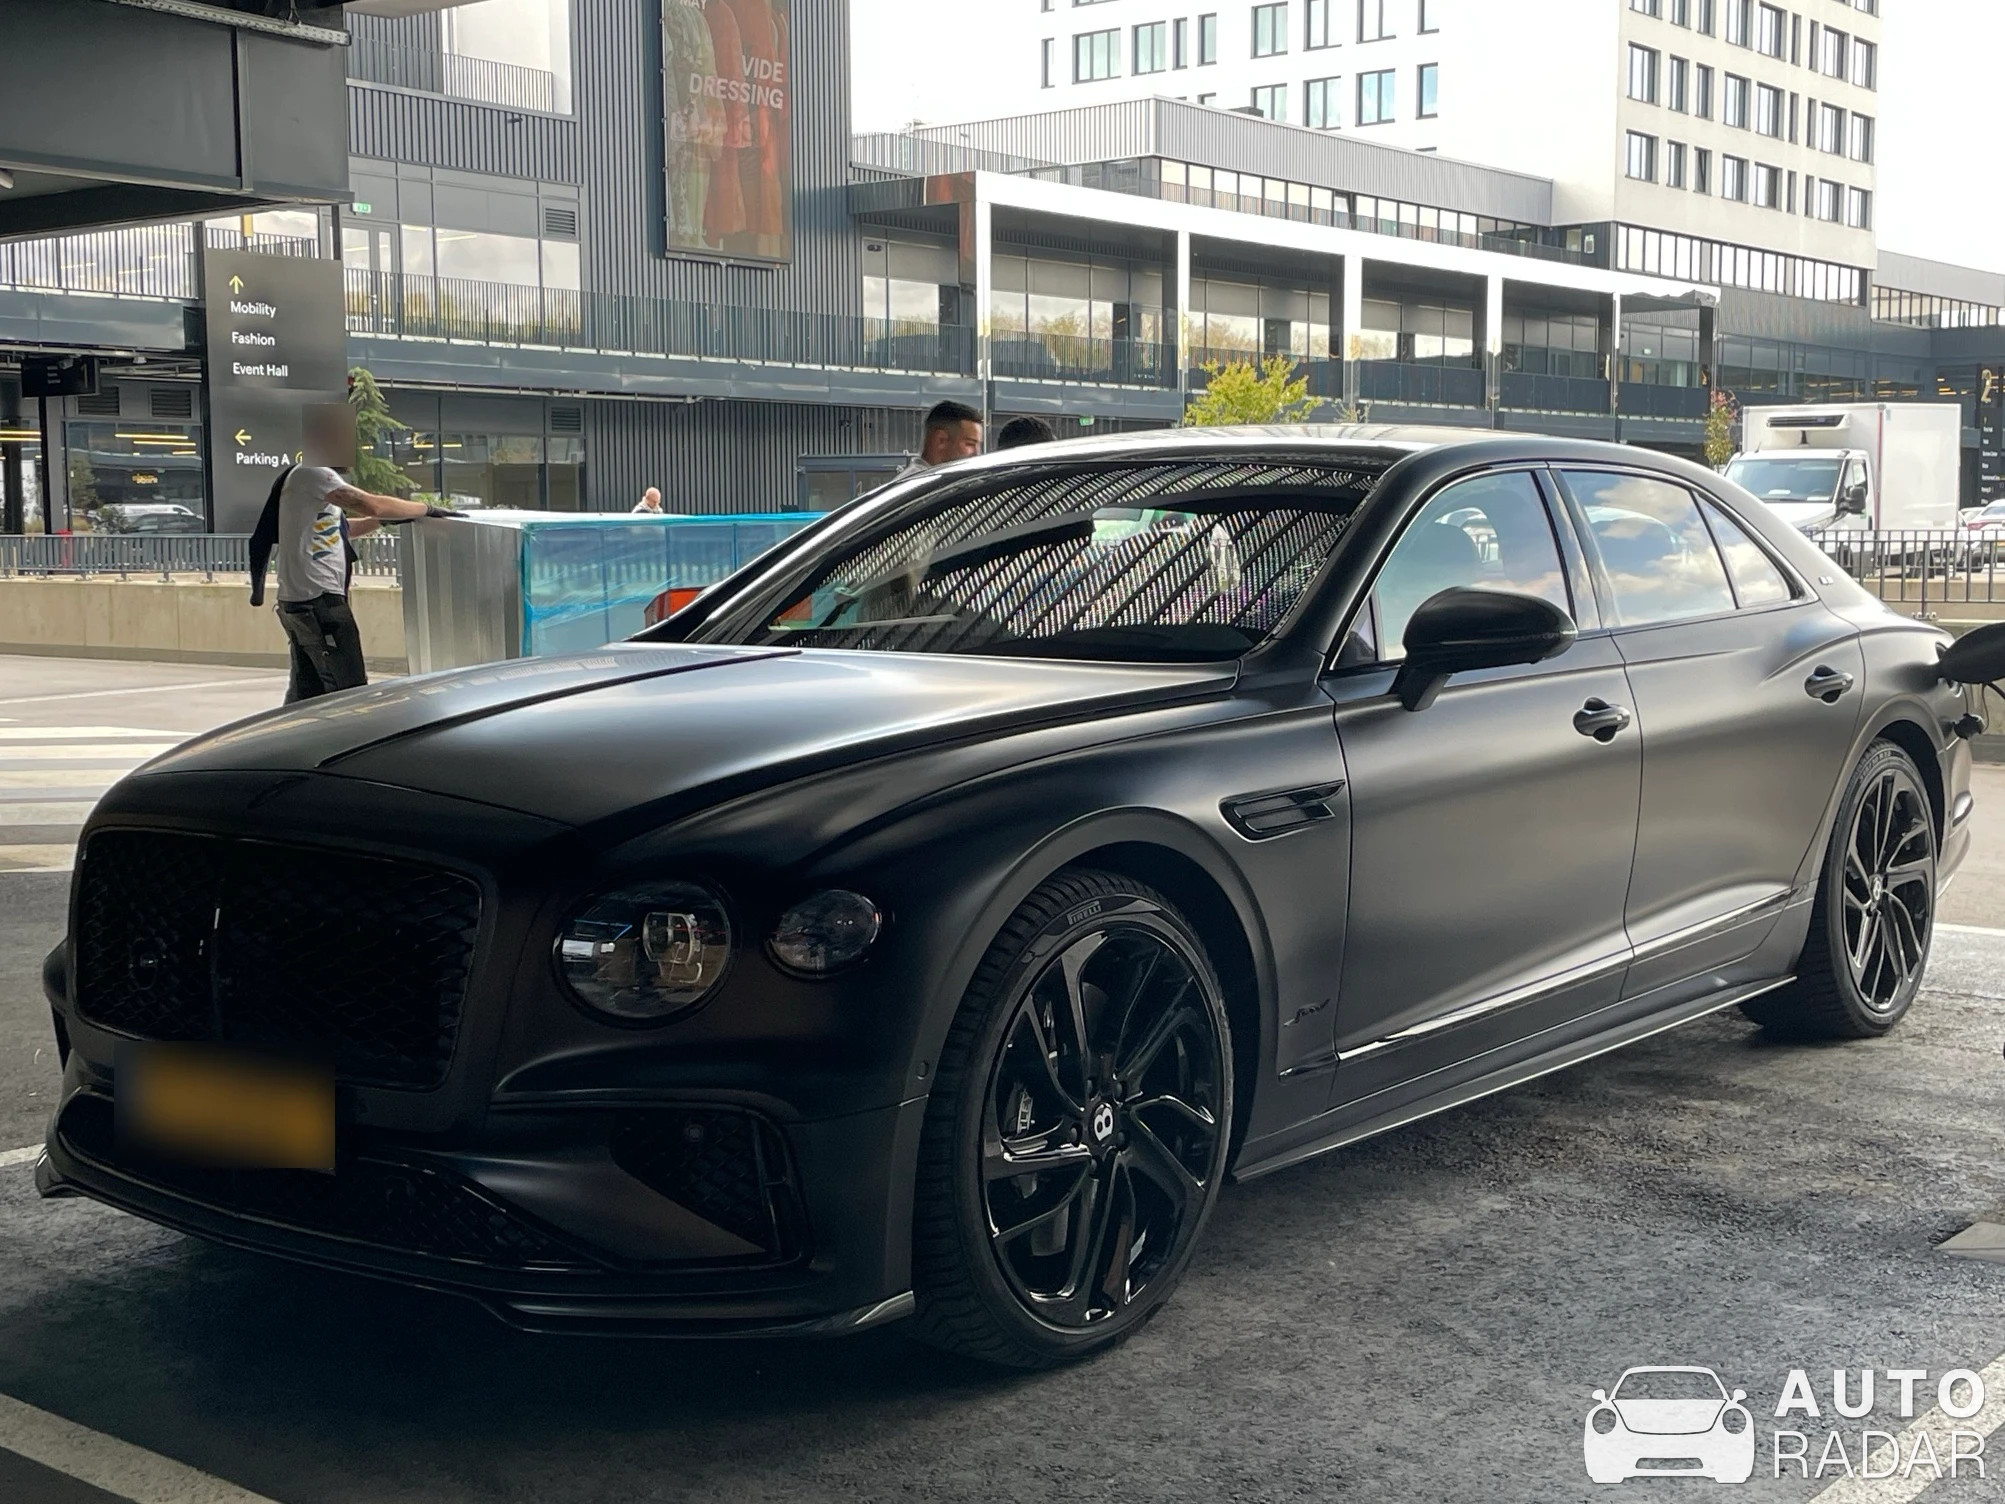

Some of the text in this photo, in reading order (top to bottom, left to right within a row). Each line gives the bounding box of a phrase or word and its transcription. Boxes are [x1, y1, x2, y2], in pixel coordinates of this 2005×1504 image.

[741, 55, 784, 83] VIDE
[689, 73, 784, 110] DRESSING
[230, 301, 277, 319] Mobility
[231, 331, 276, 347] Fashion
[232, 362, 289, 377] Event Hall
[1981, 369, 1992, 403] 2
[236, 452, 291, 468] Parking A
[1066, 900, 1102, 926] PIRELLI
